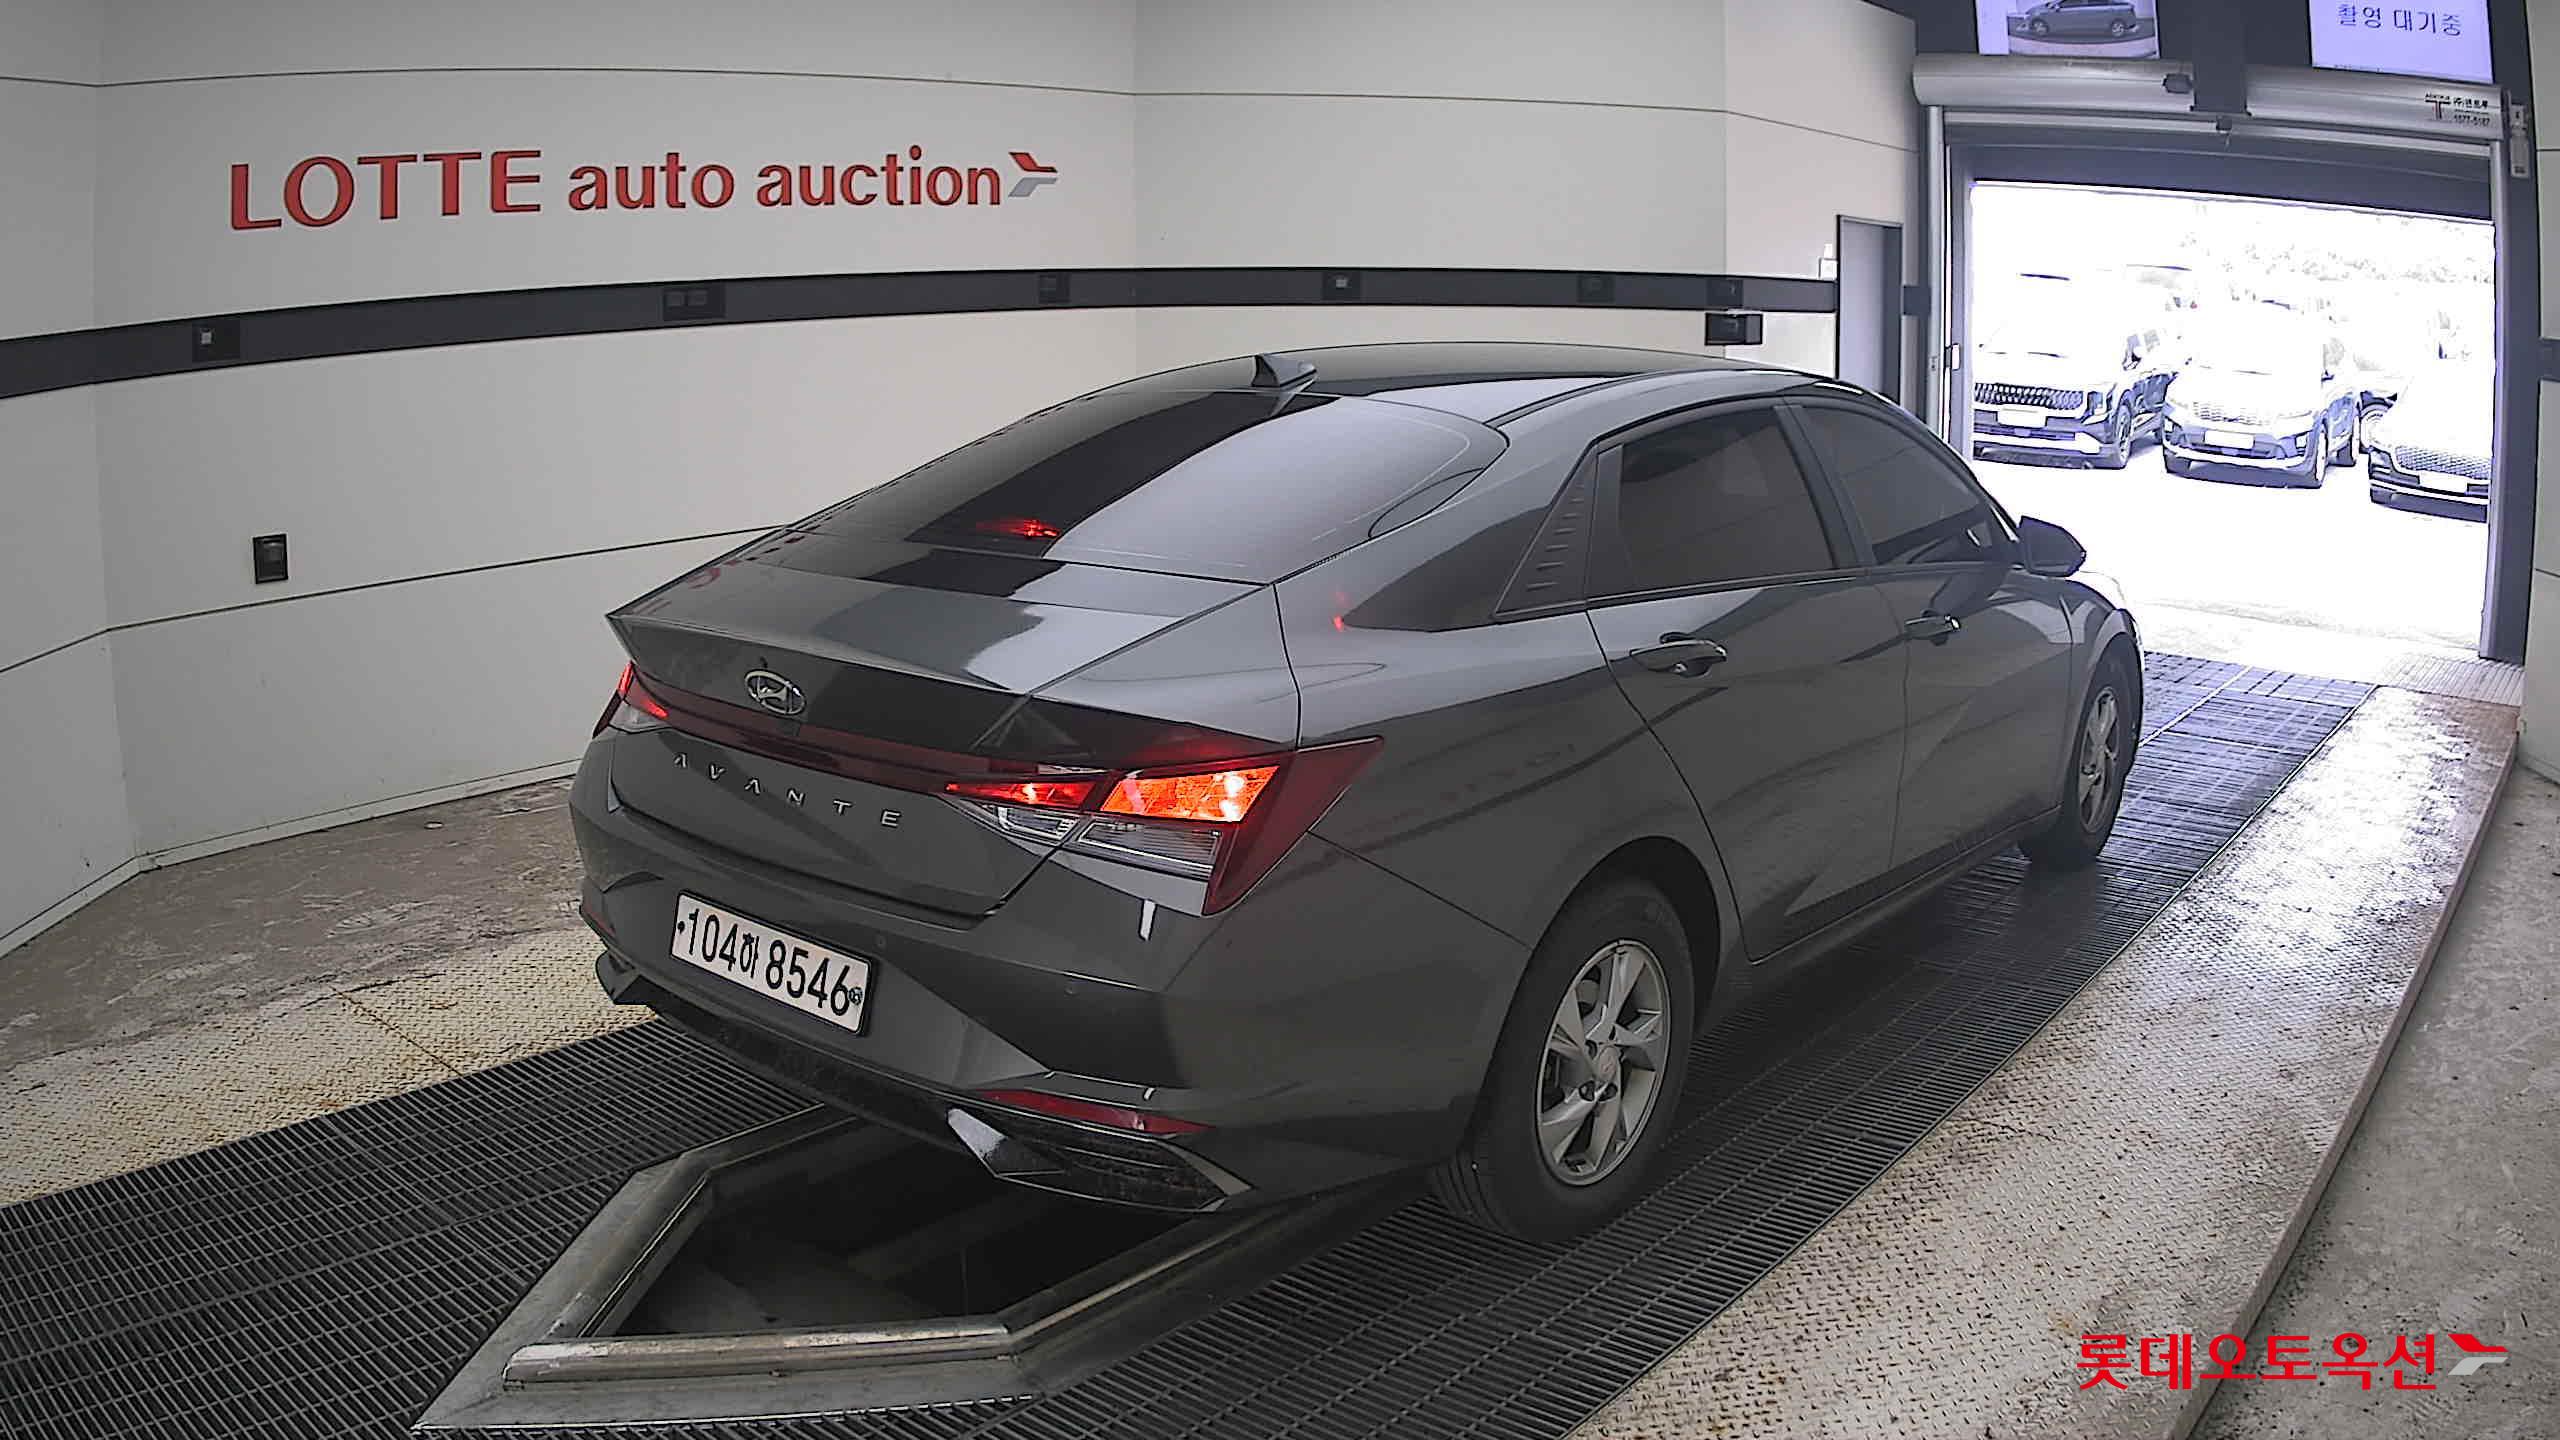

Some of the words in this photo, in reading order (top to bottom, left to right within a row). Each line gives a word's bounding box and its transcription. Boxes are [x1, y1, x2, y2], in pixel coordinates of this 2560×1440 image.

[2338, 4, 2382, 29] 촬영
[2393, 9, 2461, 36] 대기중
[230, 150, 541, 229] LOTTE
[568, 153, 735, 210] auto
[756, 146, 1002, 207] auction
[673, 753, 902, 828] AVANTE
[688, 908, 760, 979] 104하
[765, 939, 850, 1016] 8546
